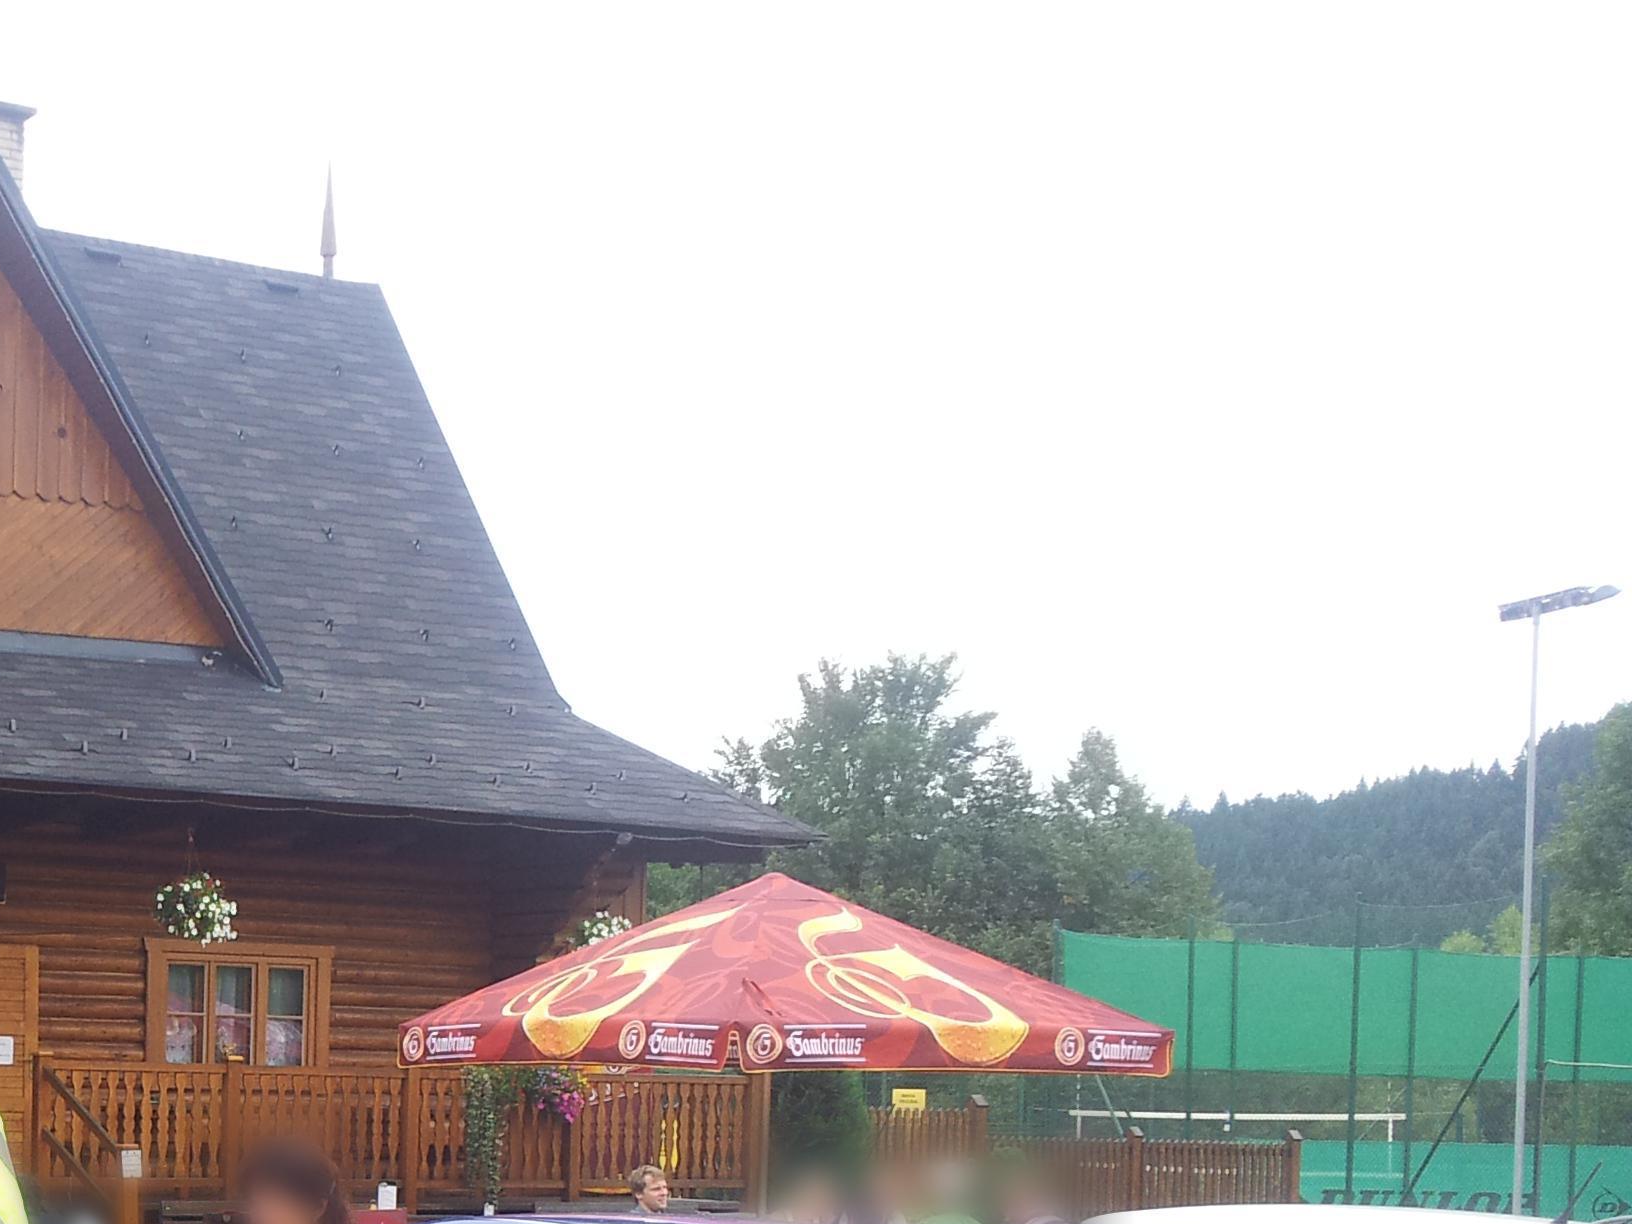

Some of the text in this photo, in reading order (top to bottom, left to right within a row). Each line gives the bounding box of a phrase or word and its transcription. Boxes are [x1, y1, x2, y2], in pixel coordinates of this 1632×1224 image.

[648, 1028, 715, 1057] Gambrinus
[786, 1030, 864, 1057] Gambrinus
[1088, 1035, 1157, 1061] Gambrinus
